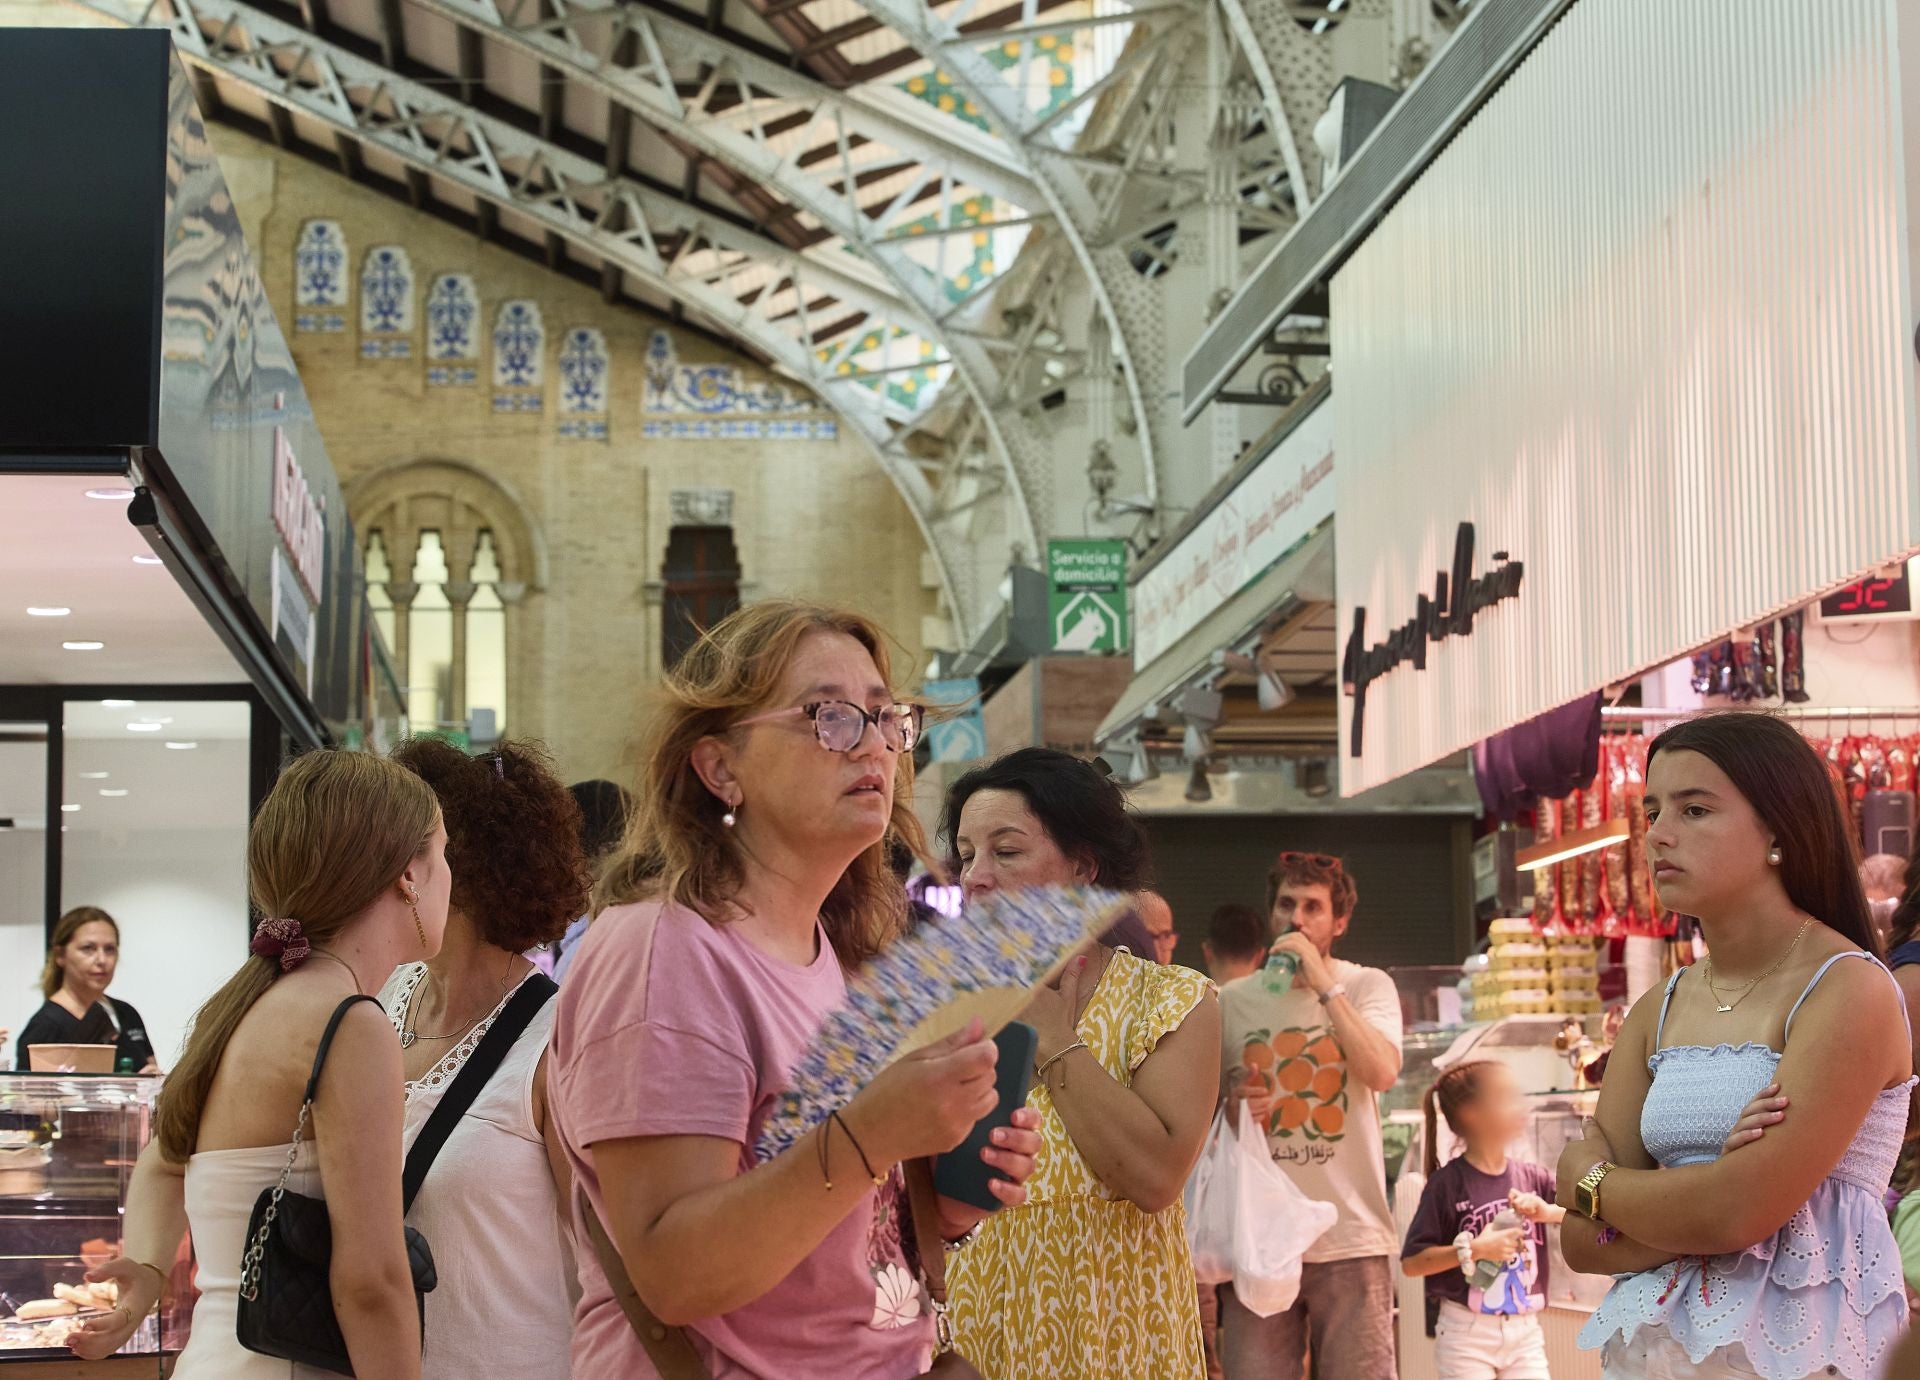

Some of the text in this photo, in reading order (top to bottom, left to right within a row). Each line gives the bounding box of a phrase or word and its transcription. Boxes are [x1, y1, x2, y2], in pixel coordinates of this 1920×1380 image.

[1052, 549, 1121, 565] Servicio a
[1054, 567, 1120, 582] domicilio
